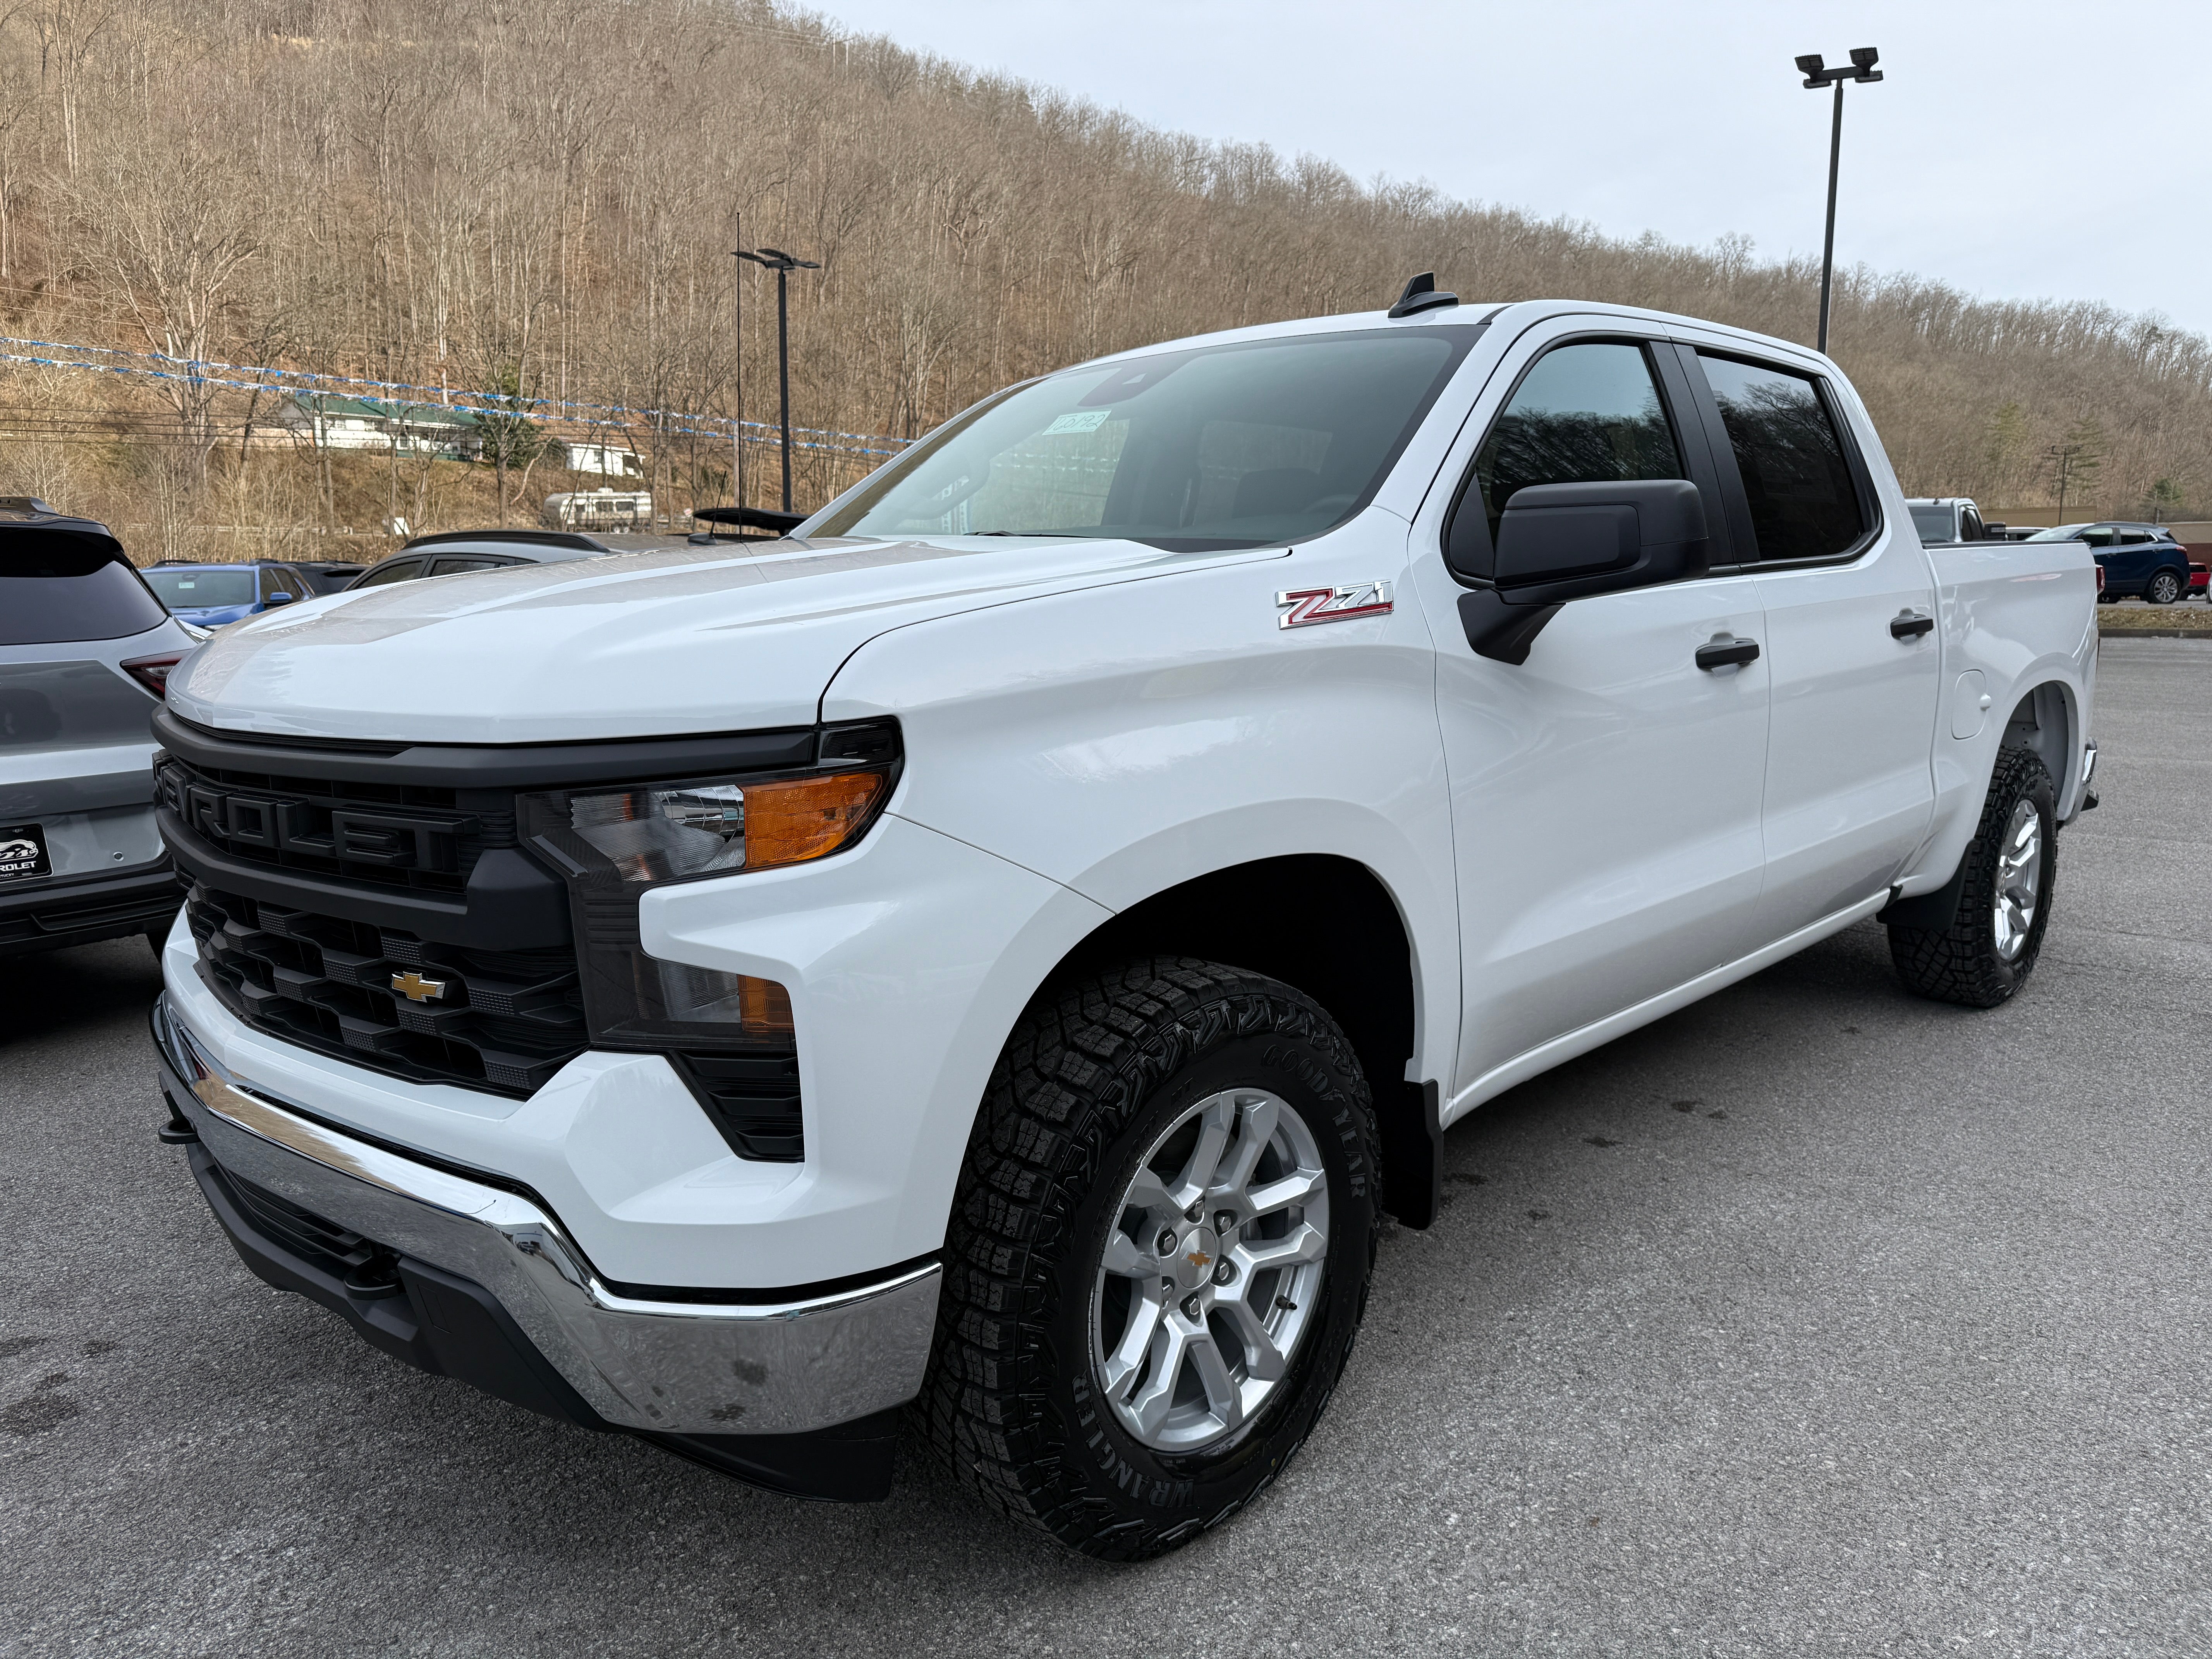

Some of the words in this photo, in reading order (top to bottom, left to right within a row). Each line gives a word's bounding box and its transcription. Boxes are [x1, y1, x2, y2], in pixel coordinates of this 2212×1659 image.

[1275, 580, 1394, 630] Z71
[1262, 1044, 1366, 1199] GOODYEAR
[1072, 1369, 1194, 1508] WRANGLER
